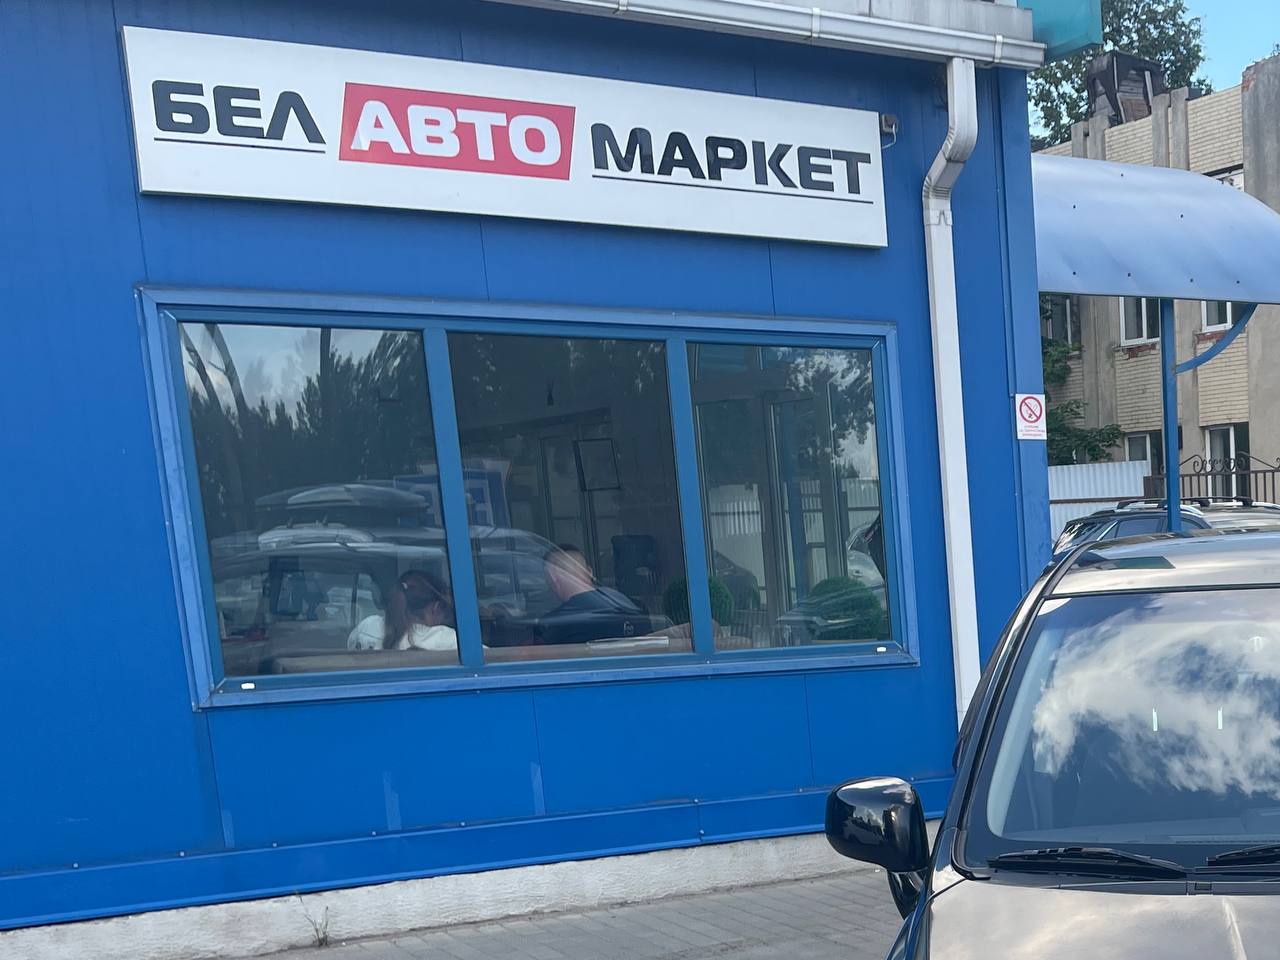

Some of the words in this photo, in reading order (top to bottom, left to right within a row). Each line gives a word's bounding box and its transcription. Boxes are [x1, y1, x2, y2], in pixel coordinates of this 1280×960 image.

[152, 80, 326, 145] БЕЛ
[350, 99, 563, 166] АВТО
[590, 122, 872, 195] МАРКЕТ
